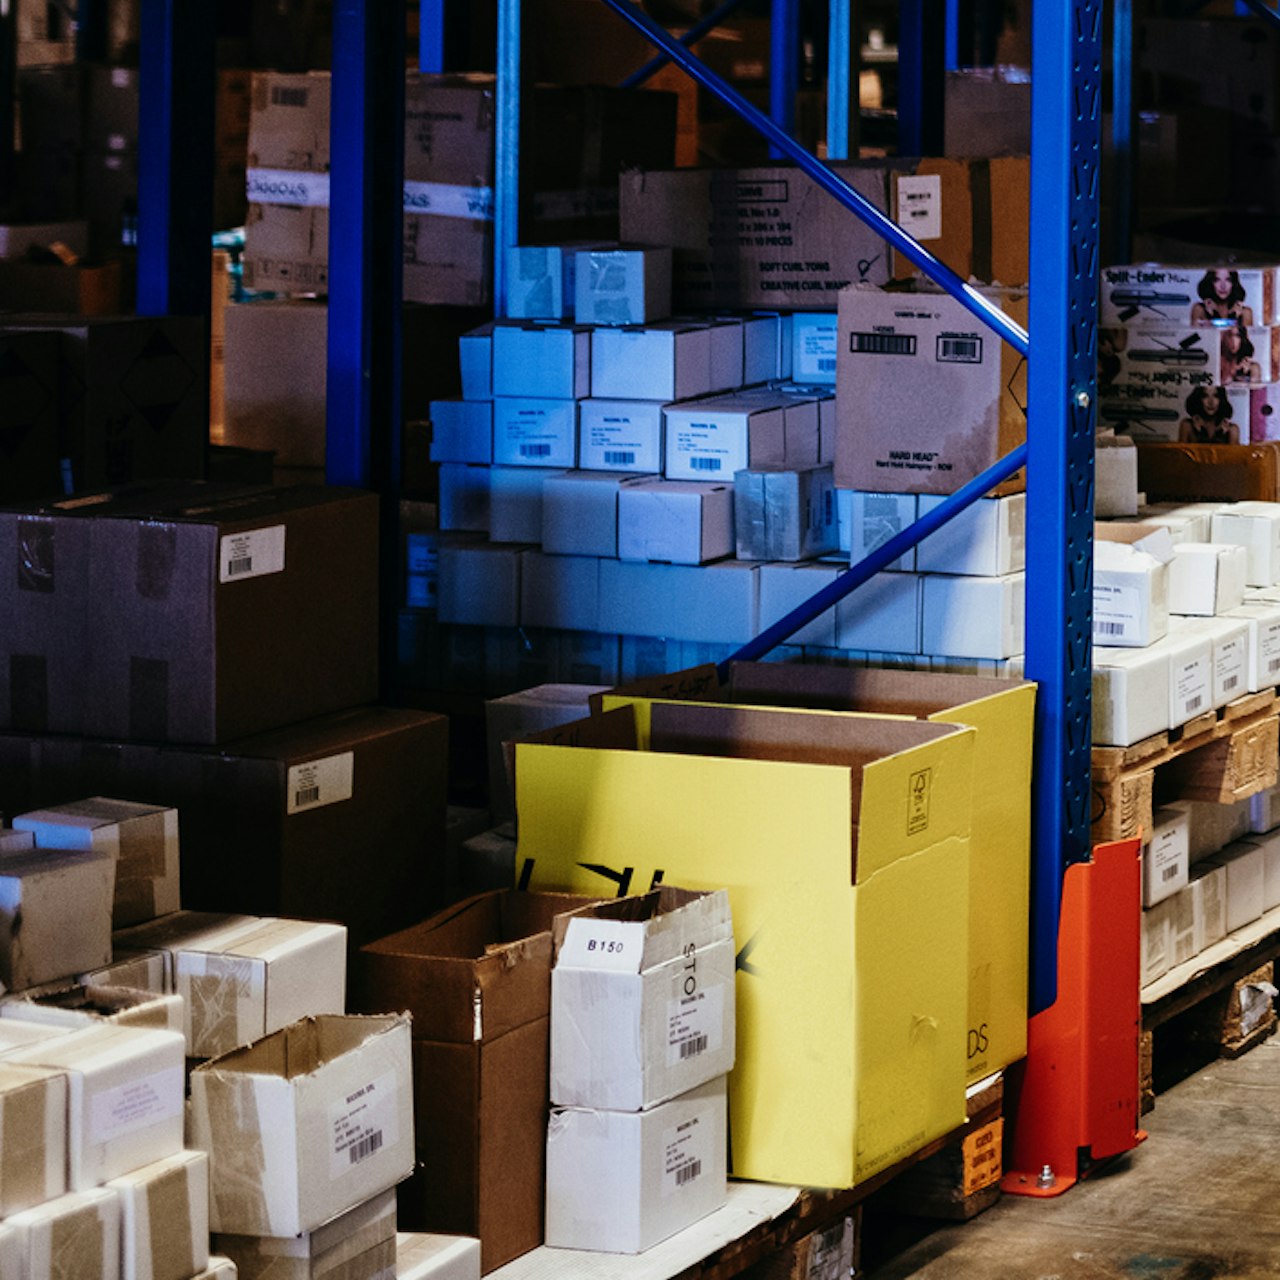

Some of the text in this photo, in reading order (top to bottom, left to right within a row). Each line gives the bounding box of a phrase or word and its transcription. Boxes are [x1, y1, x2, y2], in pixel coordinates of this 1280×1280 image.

[759, 261, 781, 273] SOFT
[1106, 270, 1167, 284] Split-Ender
[760, 280, 801, 291] CREATIVE
[889, 450, 911, 461] HARD
[587, 938, 625, 954] B150
